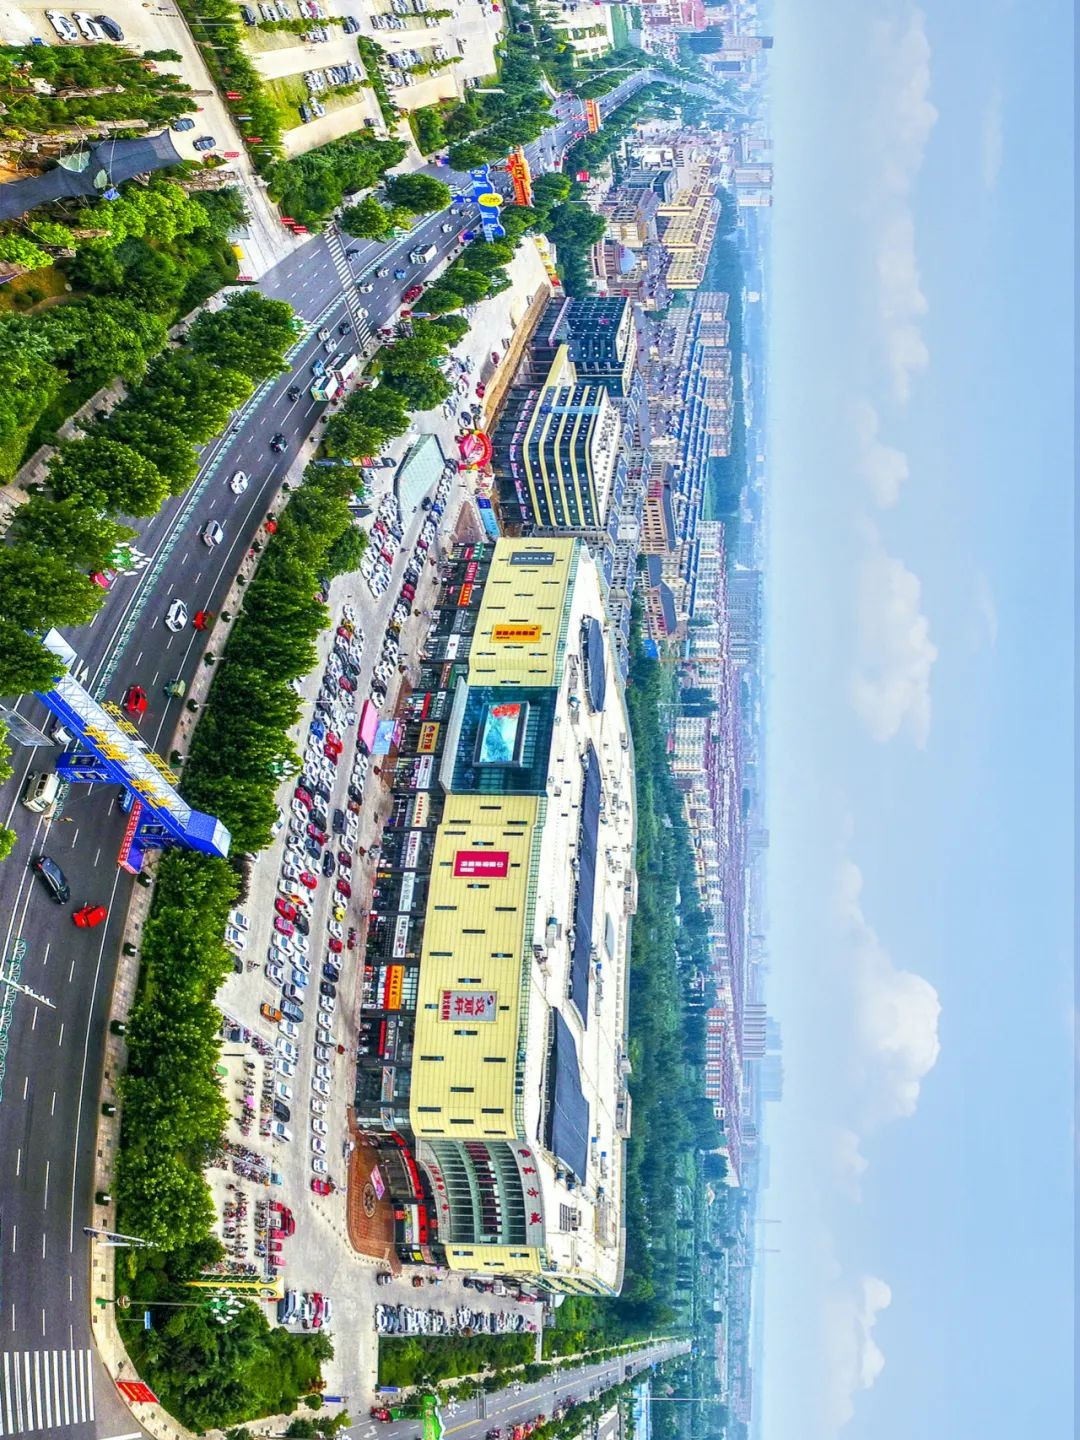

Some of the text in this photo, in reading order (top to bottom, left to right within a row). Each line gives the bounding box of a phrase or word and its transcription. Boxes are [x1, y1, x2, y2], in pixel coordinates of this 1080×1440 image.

[454, 996, 485, 1016] 汉丽轩
[522, 1166, 542, 1225] 东方城
